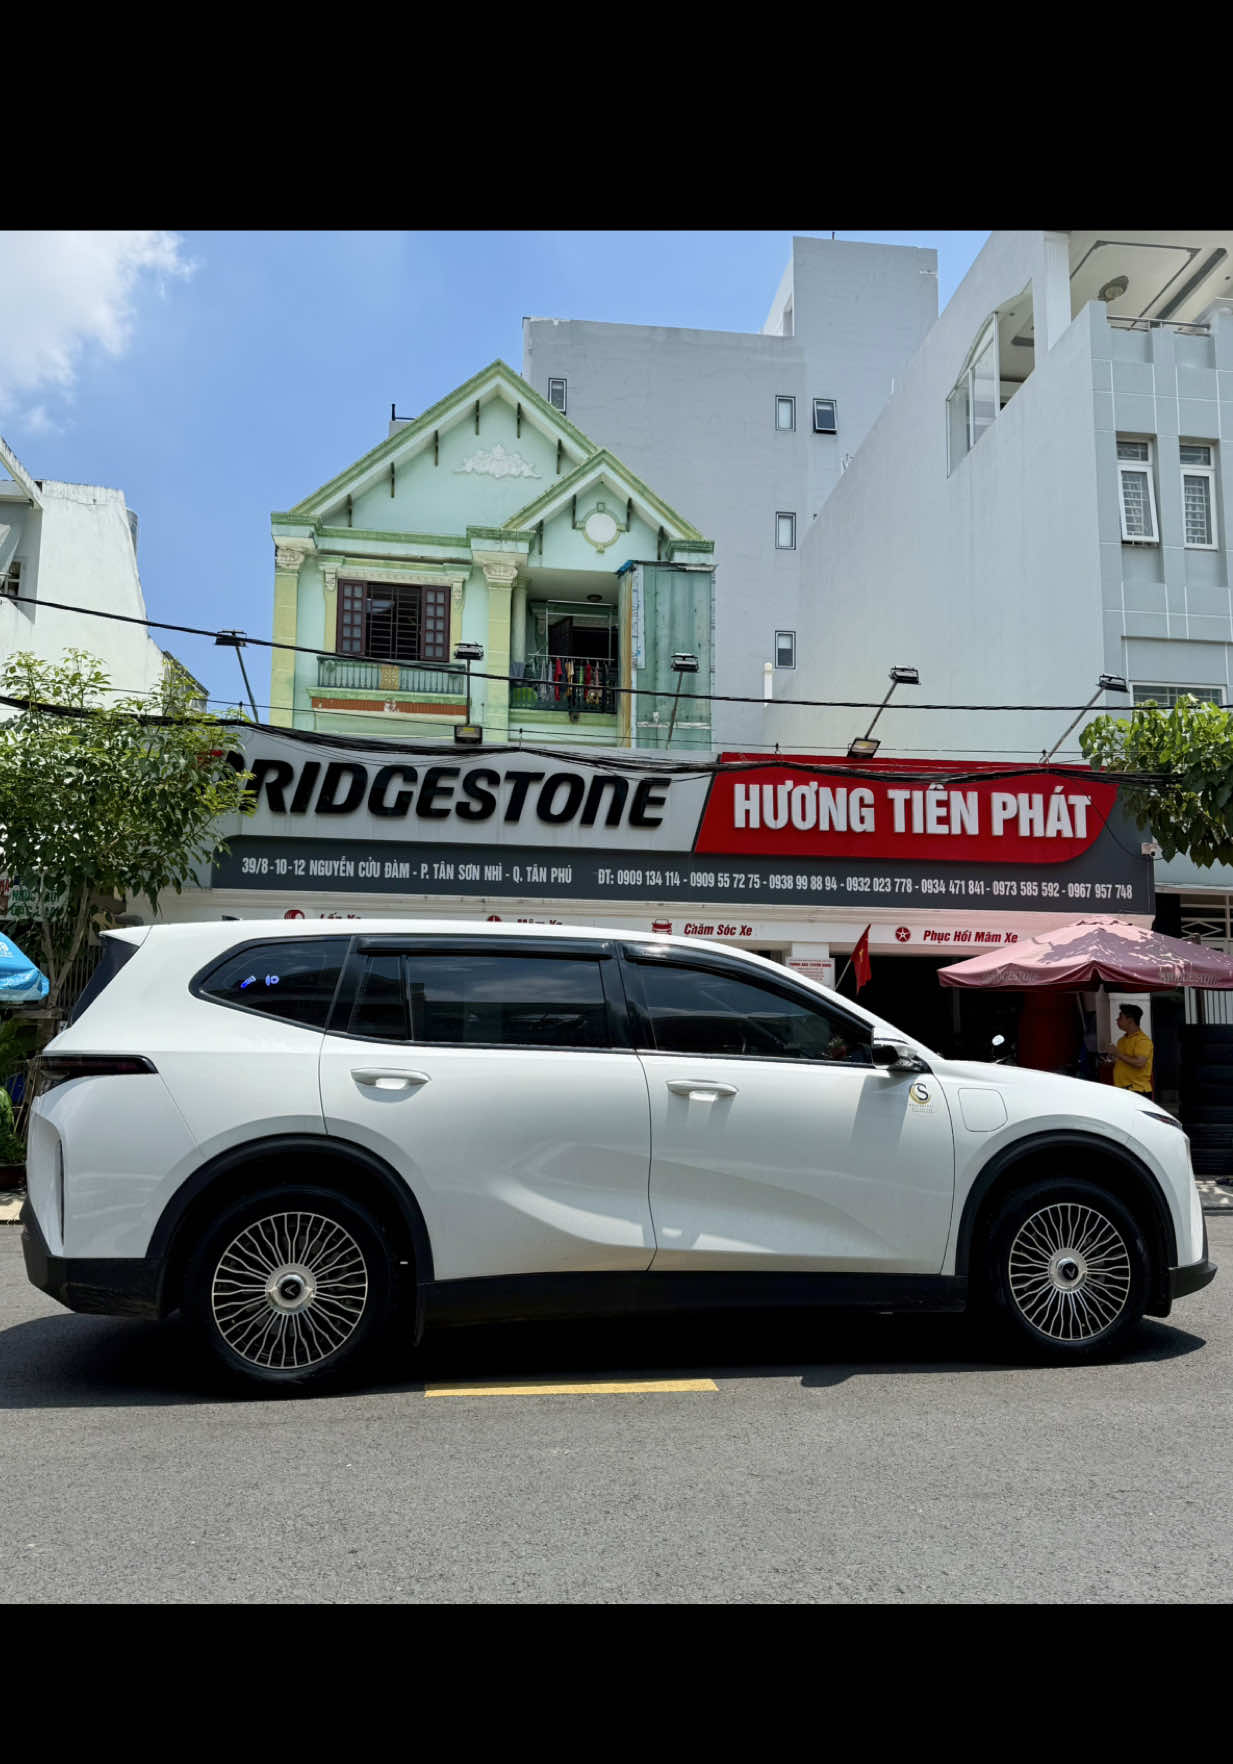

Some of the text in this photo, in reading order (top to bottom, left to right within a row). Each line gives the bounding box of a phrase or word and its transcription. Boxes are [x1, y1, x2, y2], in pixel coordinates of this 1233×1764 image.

[733, 780, 876, 833] HƯƠNG
[990, 785, 1092, 839] PHÁT
[420, 863, 430, 880] P.
[433, 861, 455, 880] TÂN
[458, 863, 480, 881] SƠN
[512, 866, 523, 884] Q.
[526, 864, 547, 883] TÂN
[598, 869, 614, 885] ĐT:
[617, 870, 642, 886] 0909
[645, 871, 662, 886] 134
[665, 871, 680, 887] 114
[690, 872, 715, 887] 0909
[717, 873, 730, 888] 55
[732, 873, 746, 889] 72
[747, 874, 760, 889] 75
[769, 874, 794, 889] 0938
[796, 875, 808, 890] 99
[810, 875, 823, 891] 88
[825, 876, 837, 891] 94
[846, 877, 870, 892] 0932
[872, 877, 891, 892] 023
[894, 878, 913, 893] 778
[921, 879, 946, 894] 0934
[949, 880, 966, 895] 471
[992, 881, 1018, 896] 0973
[1020, 881, 1038, 896] 585
[1041, 882, 1060, 897] 592
[1068, 883, 1092, 898] 0967
[1095, 884, 1113, 898] 957
[1115, 884, 1133, 899] 748
[717, 924, 737, 936] Sóc
[739, 924, 753, 937] Xe
[923, 930, 951, 943] Phục
[1004, 932, 1019, 944] Xe
